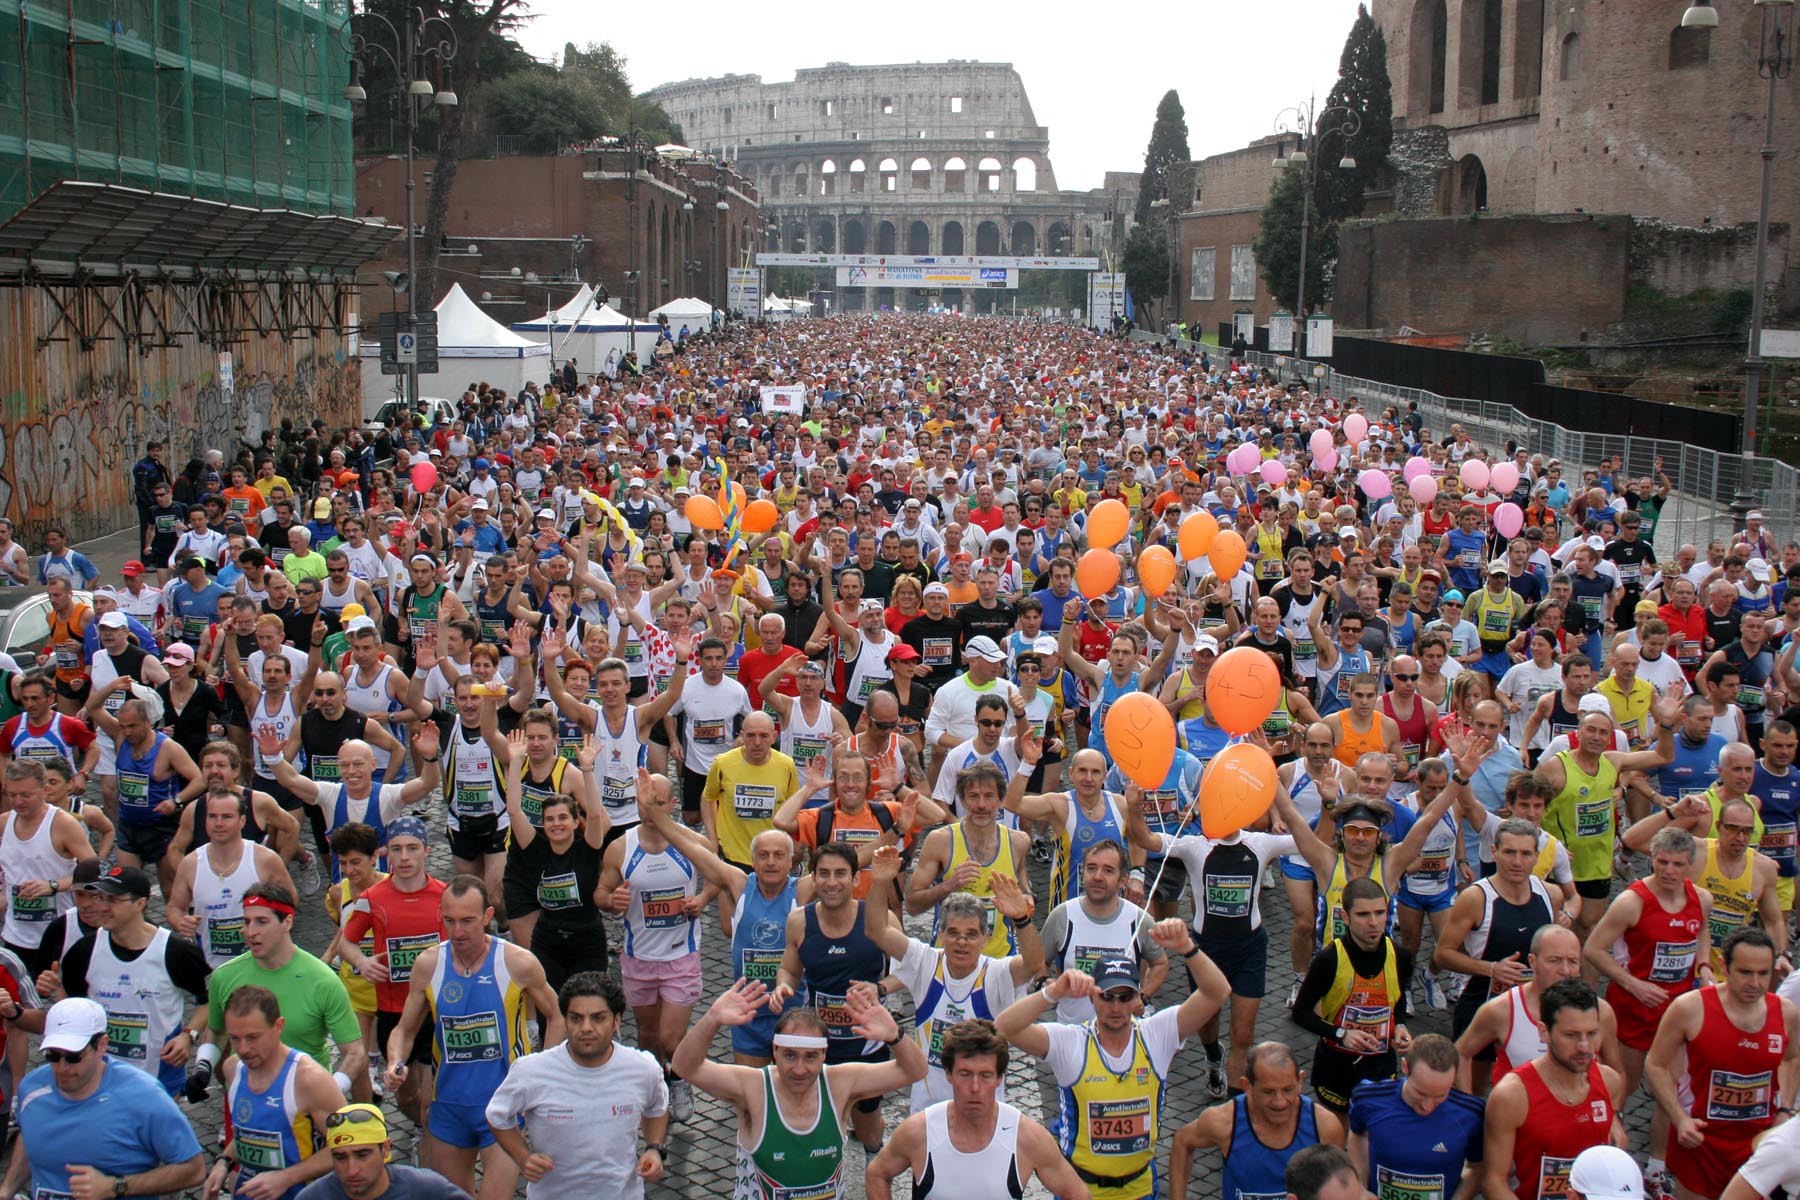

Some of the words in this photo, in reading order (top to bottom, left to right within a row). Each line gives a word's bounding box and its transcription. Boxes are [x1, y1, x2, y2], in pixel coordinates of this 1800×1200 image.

[926, 647, 944, 656] 3170
[793, 747, 816, 757] 4580
[315, 766, 337, 776] 5731
[457, 790, 479, 801] 5381
[603, 787, 625, 798] 9257
[735, 797, 764, 807] 11773
[1579, 813, 1603, 825] 5790
[542, 889, 566, 899] 1213
[1209, 890, 1238, 902] 5422
[647, 902, 670, 915] 870
[210, 930, 241, 943] 6354
[1656, 956, 1687, 968] 12810
[745, 964, 777, 977] 5386
[452, 1015, 494, 1026] AceaElectrabel
[819, 1009, 852, 1023] 2958
[446, 1030, 481, 1046] 4130
[1714, 1087, 1753, 1104] 2712
[1102, 1101, 1149, 1112] AceaElectrabel
[1092, 1119, 1134, 1136] 3743
[809, 1145, 837, 1158] Alitalia
[1391, 1175, 1442, 1186] AceaElectrabel
[788, 1183, 834, 1199] AceaElectrabel
